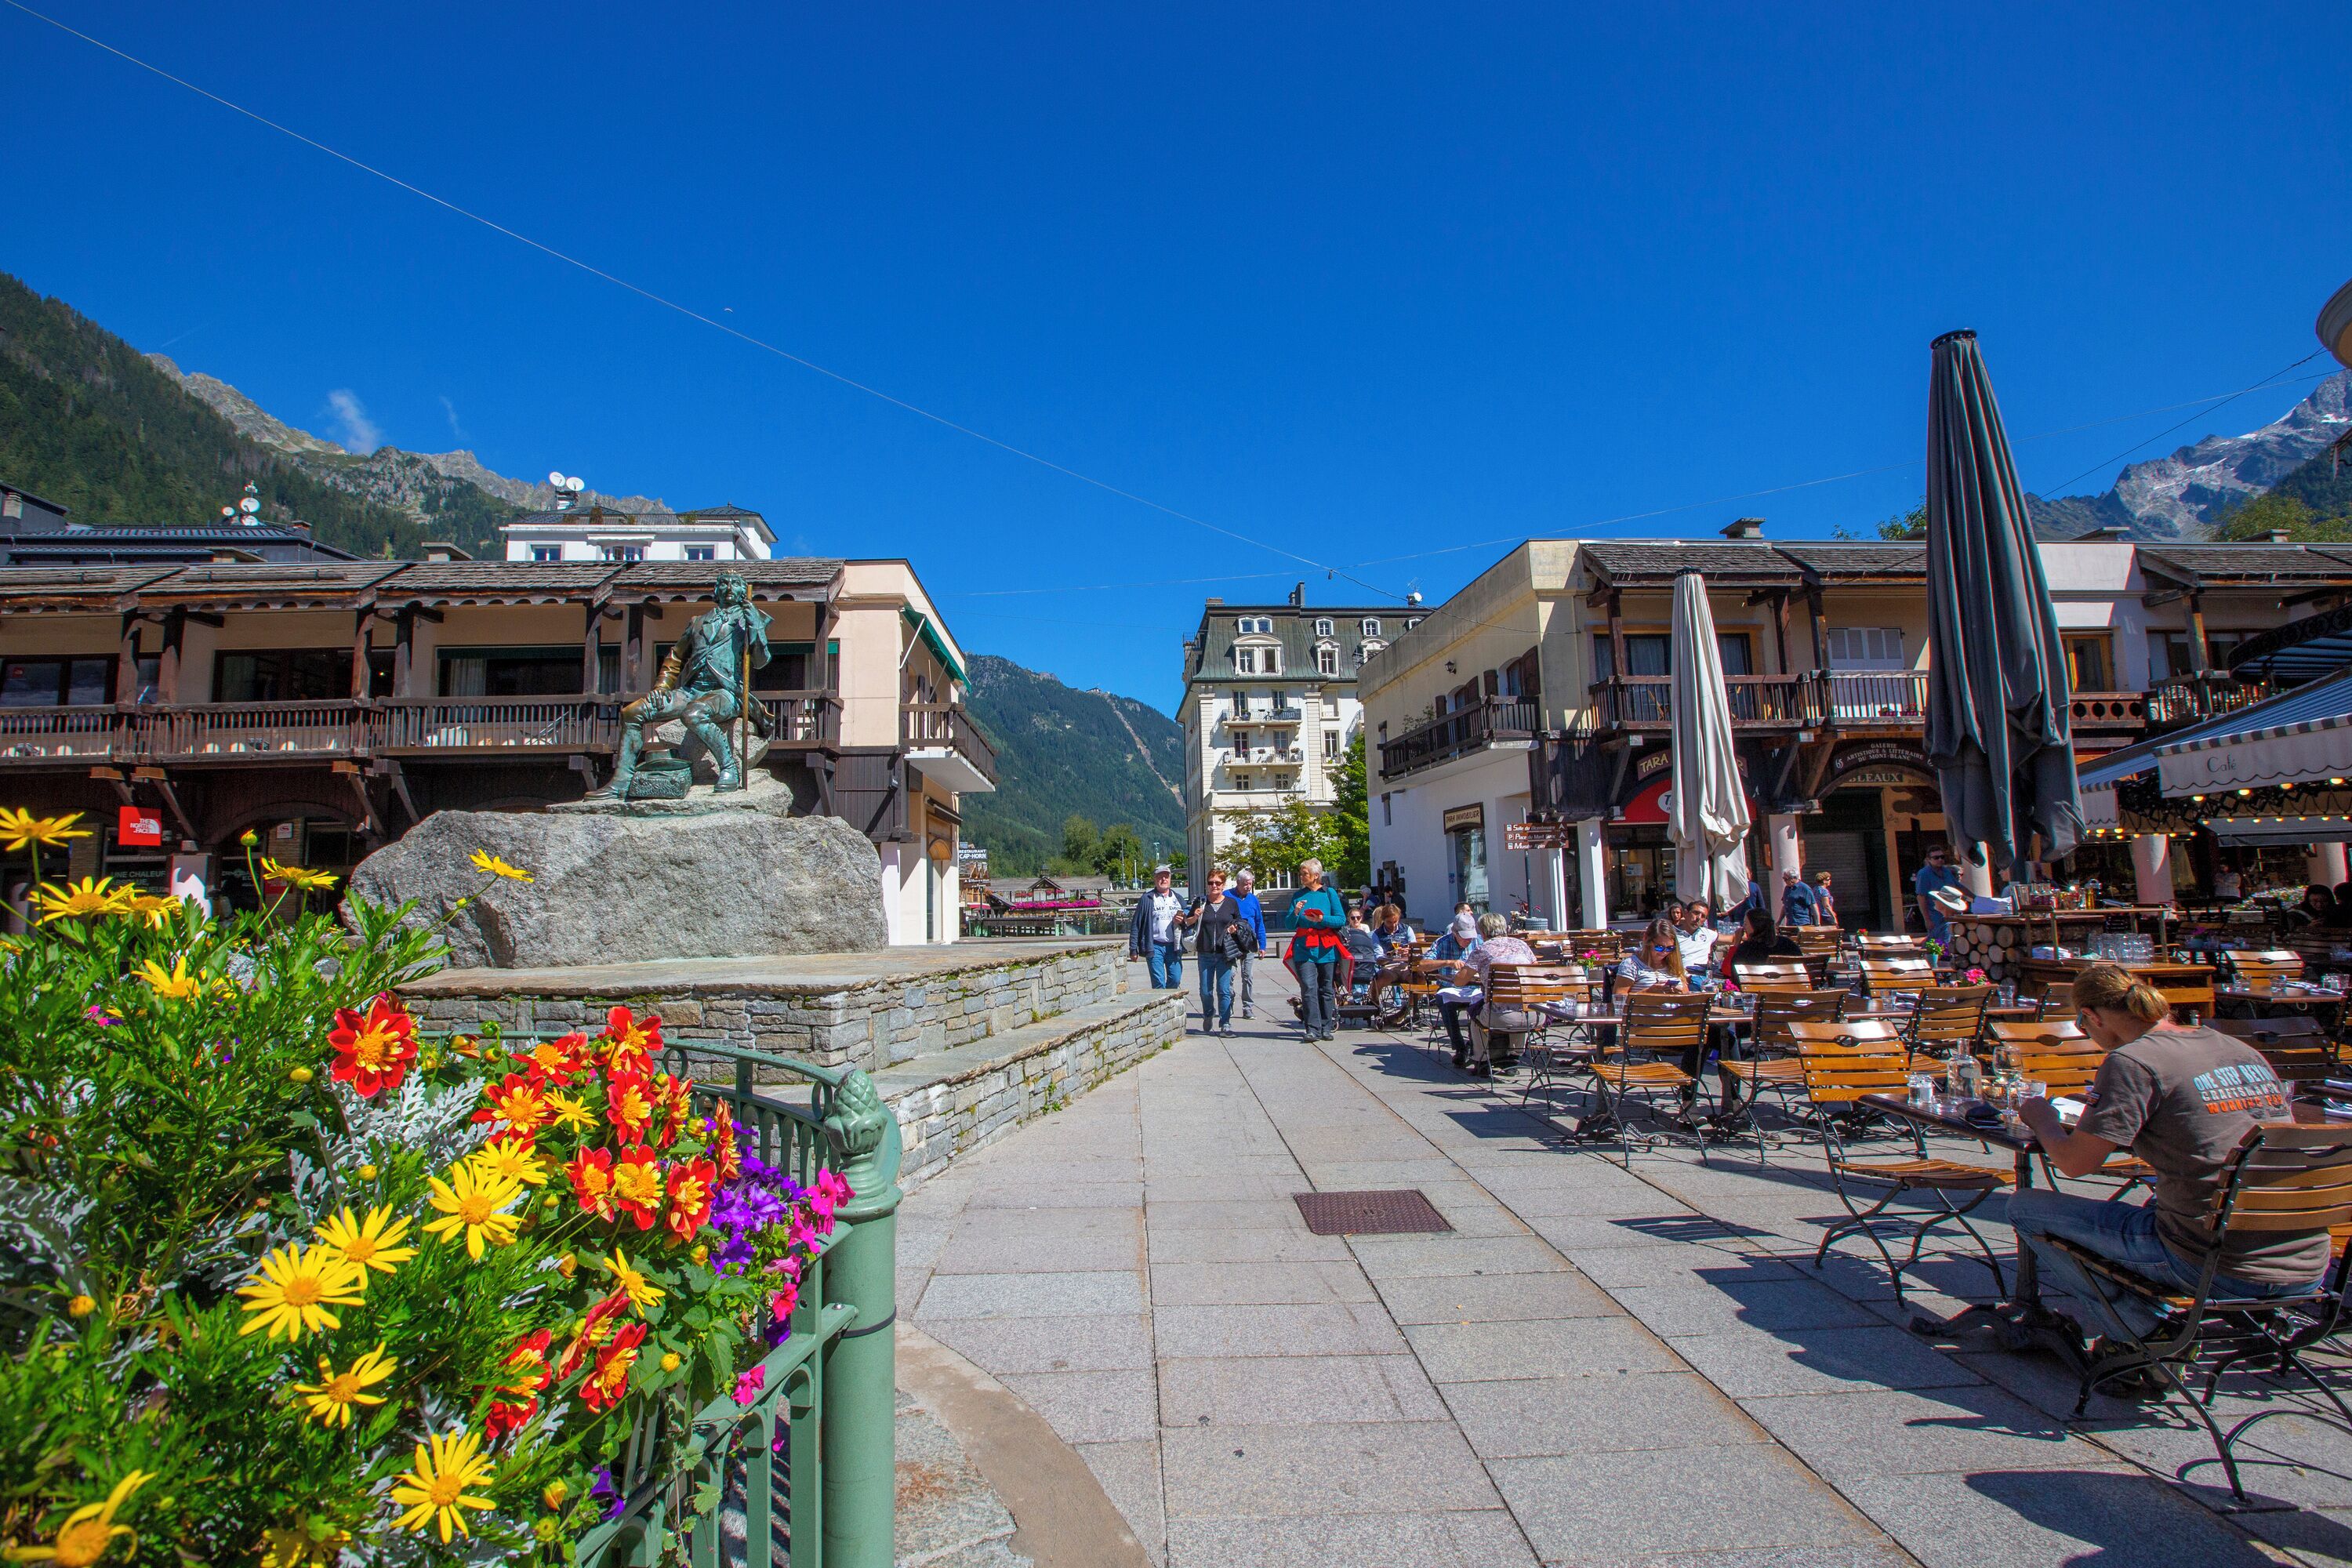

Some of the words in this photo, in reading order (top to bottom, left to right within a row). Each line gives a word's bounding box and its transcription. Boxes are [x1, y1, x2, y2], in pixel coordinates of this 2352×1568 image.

[1640, 753, 1669, 773] TARA
[1835, 758, 1843, 769] 65
[1846, 749, 1880, 761] ARTISTIQUE
[2207, 754, 2236, 772] Café
[2193, 1072, 2219, 1091] ONE
[2213, 1066, 2242, 1087] STEP
